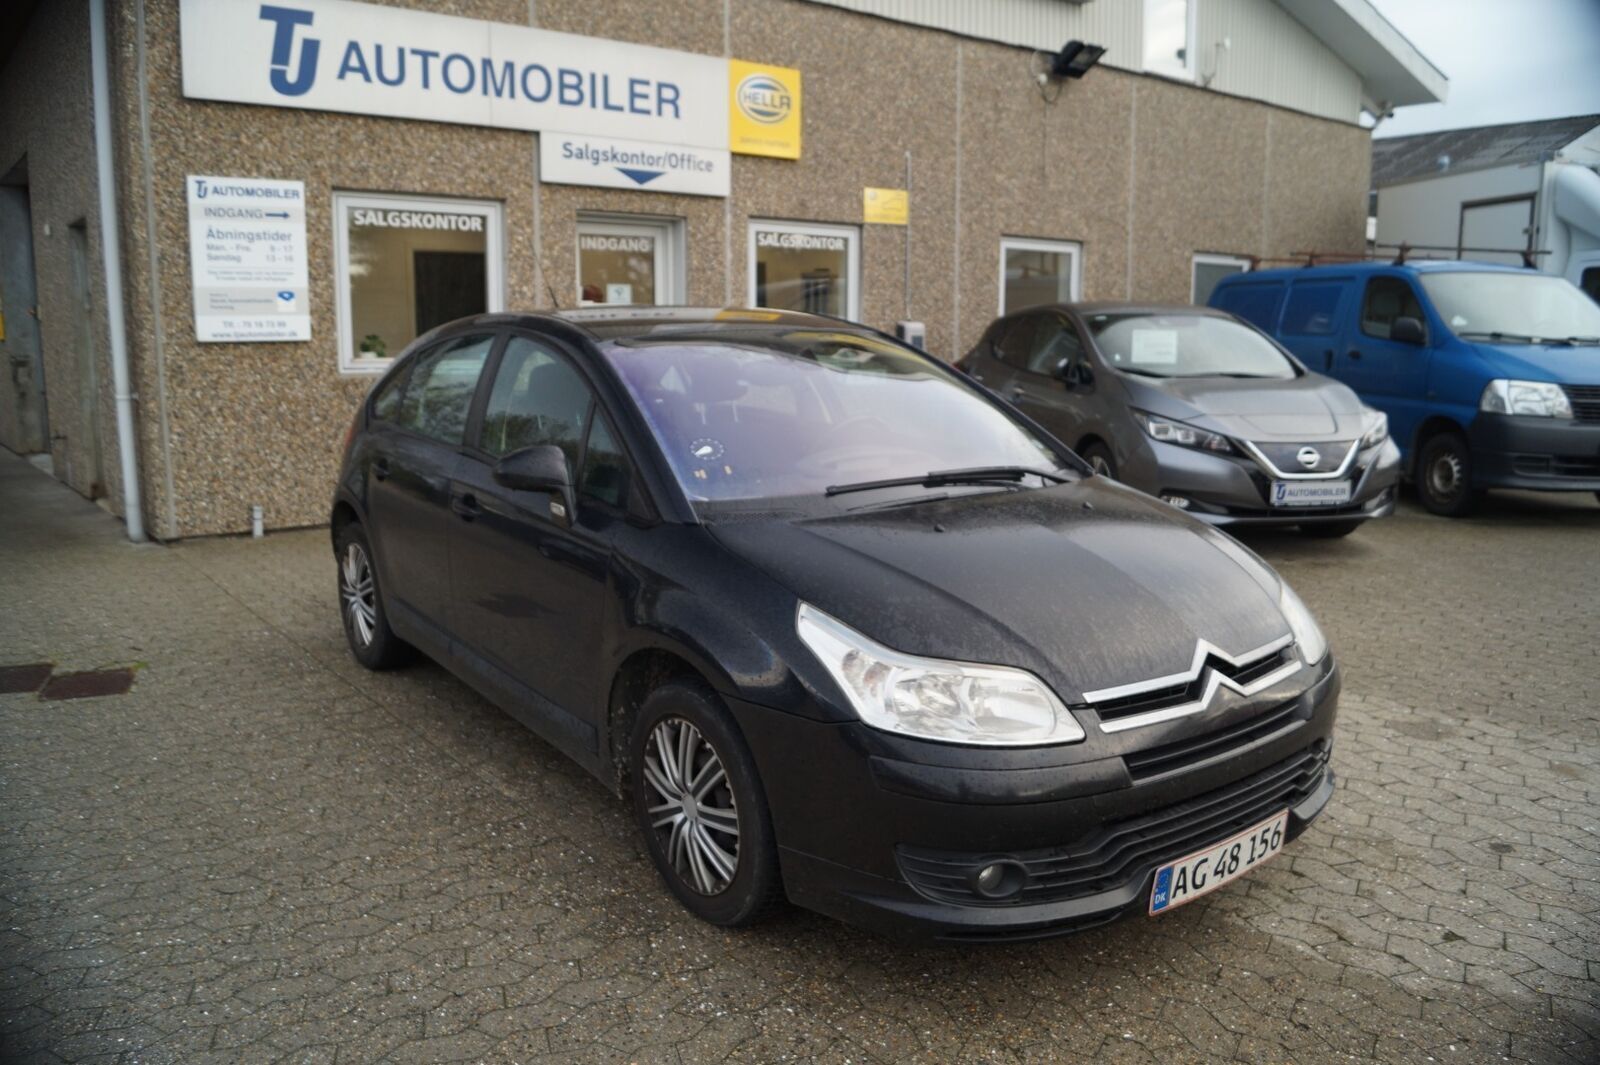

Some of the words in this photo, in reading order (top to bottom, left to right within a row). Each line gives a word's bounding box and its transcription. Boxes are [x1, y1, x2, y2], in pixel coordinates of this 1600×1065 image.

[336, 40, 681, 119] AUTOMOBILER
[743, 90, 791, 110] HELLA
[562, 142, 714, 173] Salgskontor/Office
[211, 186, 301, 199] AUTOMOBILER
[204, 207, 264, 219] INDGANG
[353, 209, 483, 232] SALGSKONTOR
[206, 226, 293, 243] Åbningstider
[757, 232, 845, 250] SALGSKONTOR
[580, 236, 650, 252] INDGANG
[1287, 487, 1346, 498] AUTOMOBILER
[1171, 857, 1209, 899] AG
[1213, 842, 1242, 879] 48
[1246, 820, 1282, 866] 156
[1154, 892, 1166, 905] DK
